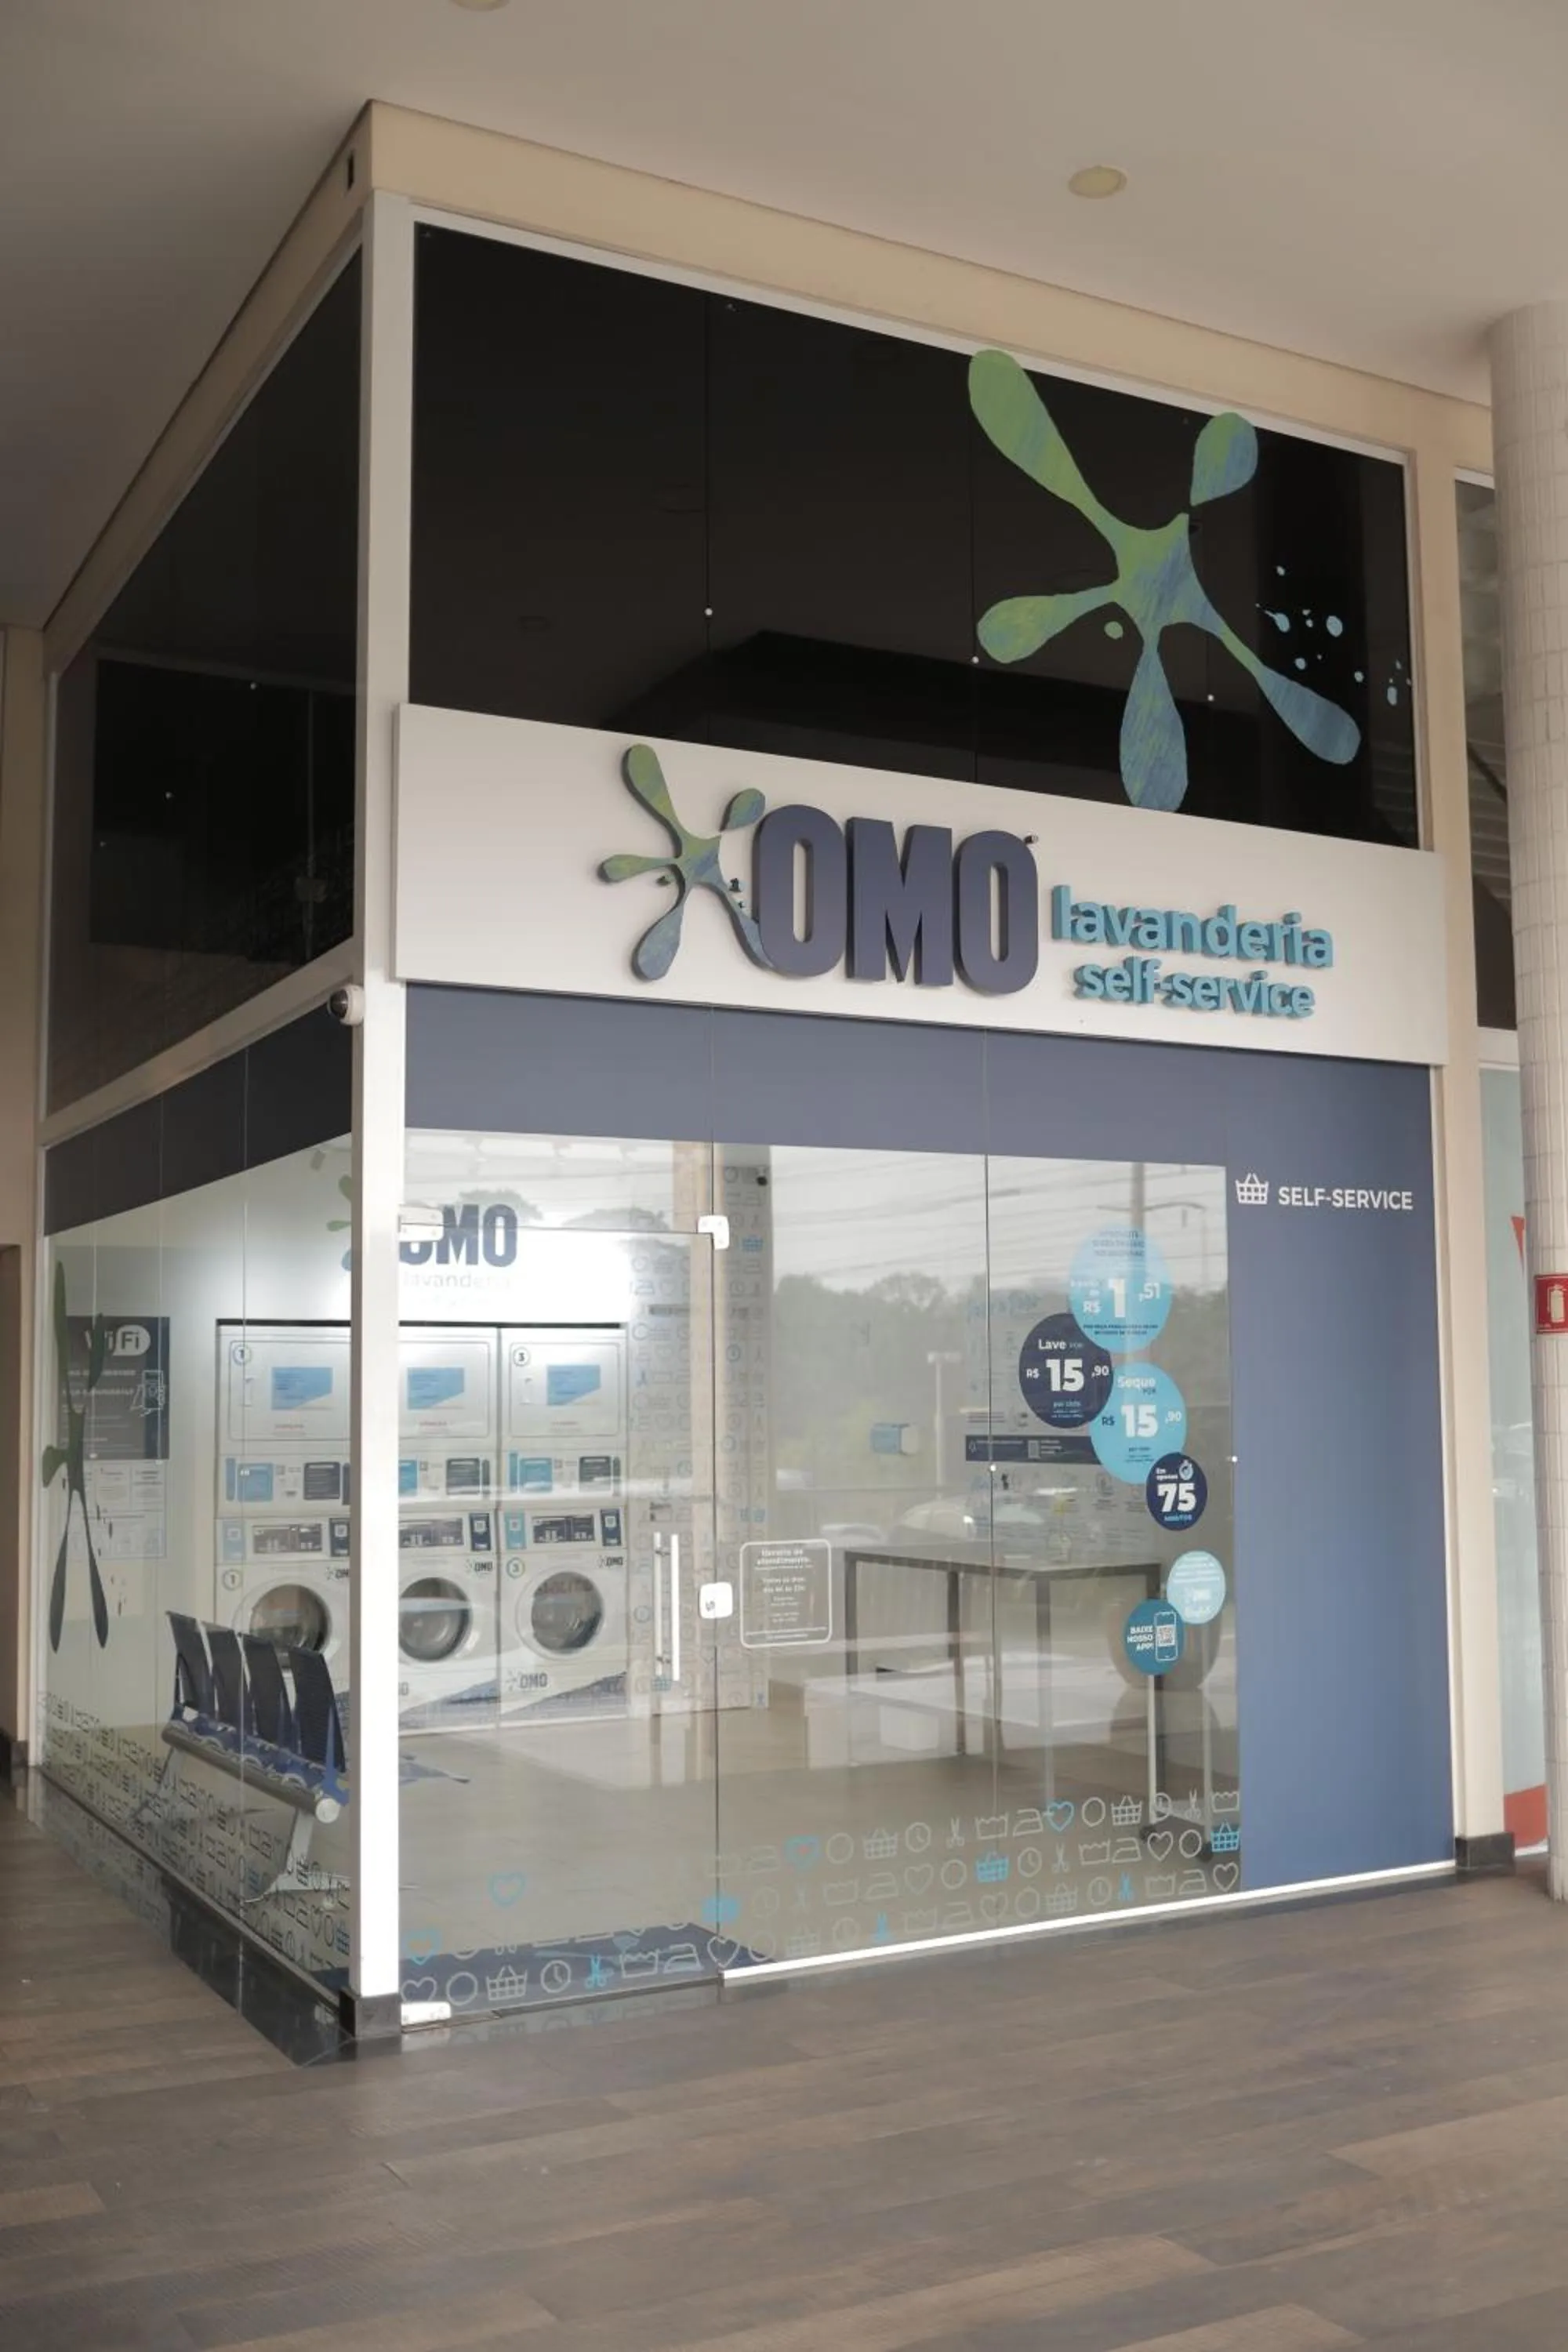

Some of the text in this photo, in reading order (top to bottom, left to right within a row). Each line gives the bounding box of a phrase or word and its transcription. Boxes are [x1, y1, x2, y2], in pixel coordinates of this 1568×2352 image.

[752, 804, 1039, 996] OMO
[1051, 884, 1334, 969] lavanderia
[1073, 956, 1316, 1018] self-service
[1278, 1186, 1414, 1210] SELF-SERVICE
[1108, 1279, 1126, 1318] 1
[1038, 1338, 1066, 1350] Lave
[1026, 1359, 1109, 1392] R$ 15 ,90
[1117, 1376, 1156, 1390] Seque
[1102, 1416, 1115, 1426] R$
[1120, 1405, 1159, 1438] 15
[1157, 1483, 1197, 1512] 75
